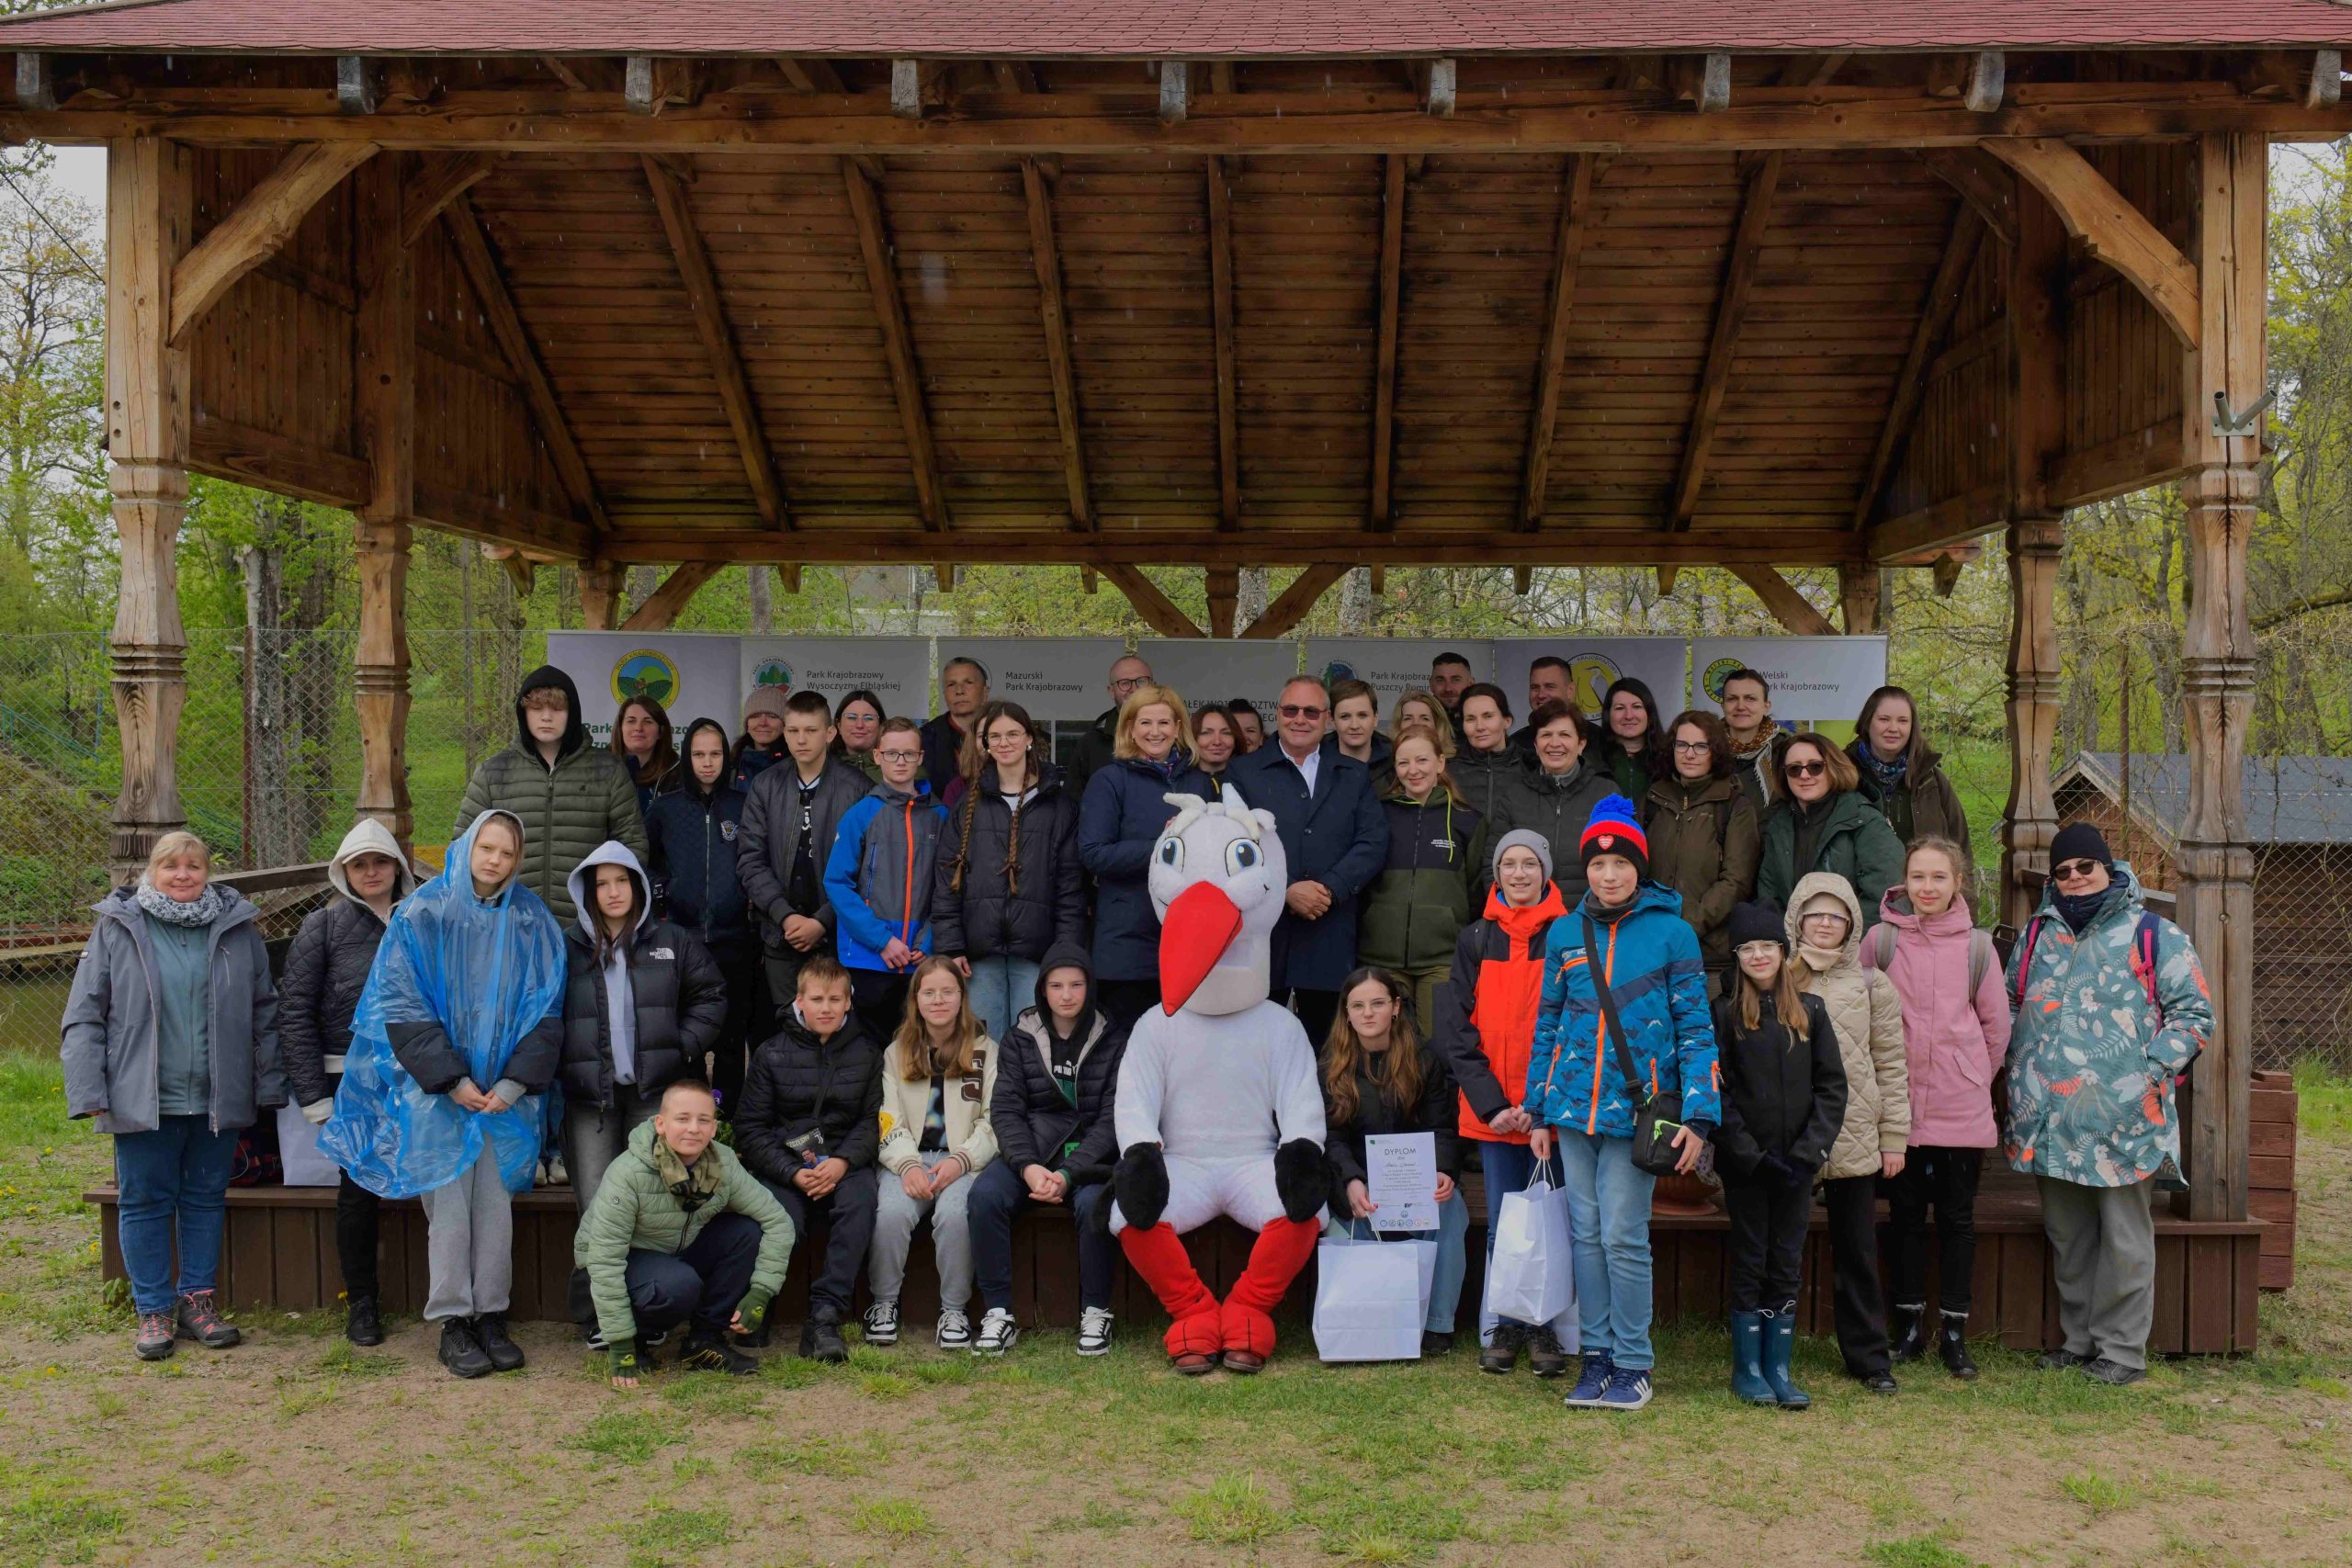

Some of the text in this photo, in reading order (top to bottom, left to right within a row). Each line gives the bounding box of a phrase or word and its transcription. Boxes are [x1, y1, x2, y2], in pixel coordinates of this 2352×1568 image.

[807, 671, 884, 681] Park Krajobrazowy
[1005, 671, 1043, 680] Mazurski
[1371, 671, 1430, 682] Park Krajobraz
[1759, 671, 1789, 679] Welski
[807, 682, 858, 692] Wysoczyzny
[860, 682, 900, 692] Elbląskiej
[1005, 682, 1083, 693] Park Krajobrazowy
[1781, 682, 1839, 692] Krajobrazowy
[582, 723, 613, 734] Park
[1385, 1147, 1417, 1156] DYPLOM
